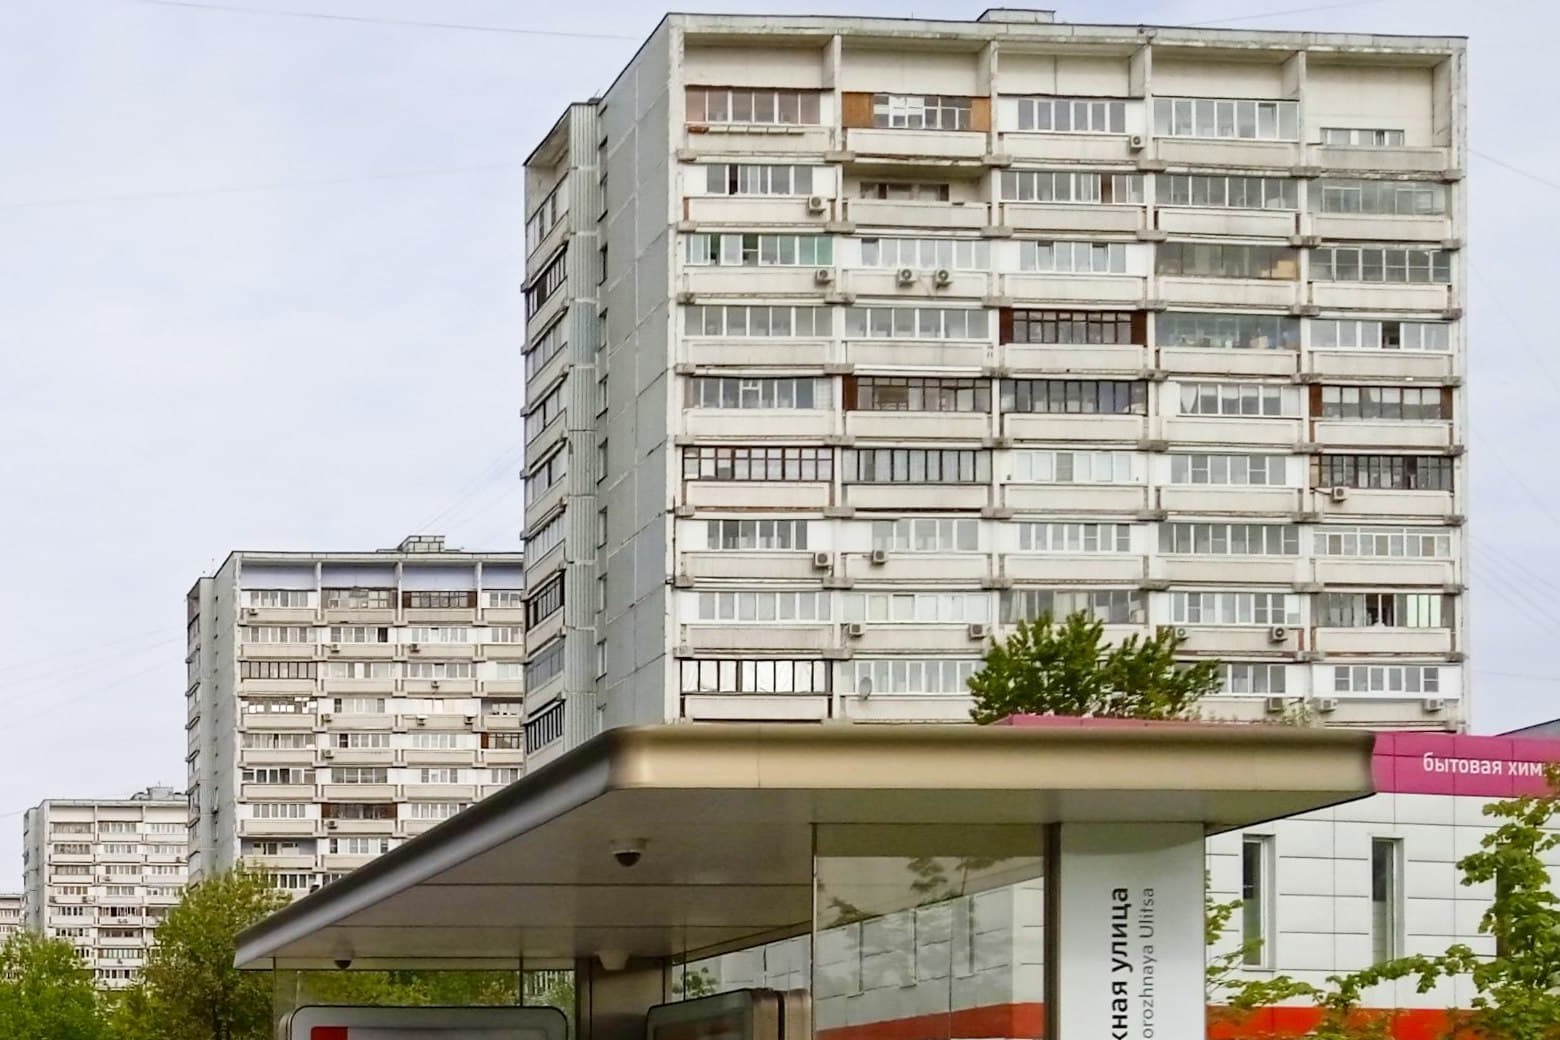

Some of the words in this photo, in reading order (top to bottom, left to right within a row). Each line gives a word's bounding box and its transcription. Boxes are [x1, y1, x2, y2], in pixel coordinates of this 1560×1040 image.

[1423, 752, 1502, 775] бытовая
[1507, 761, 1547, 777] хим
[1111, 887, 1133, 973] улица
[1138, 887, 1155, 939] Ulitsa
